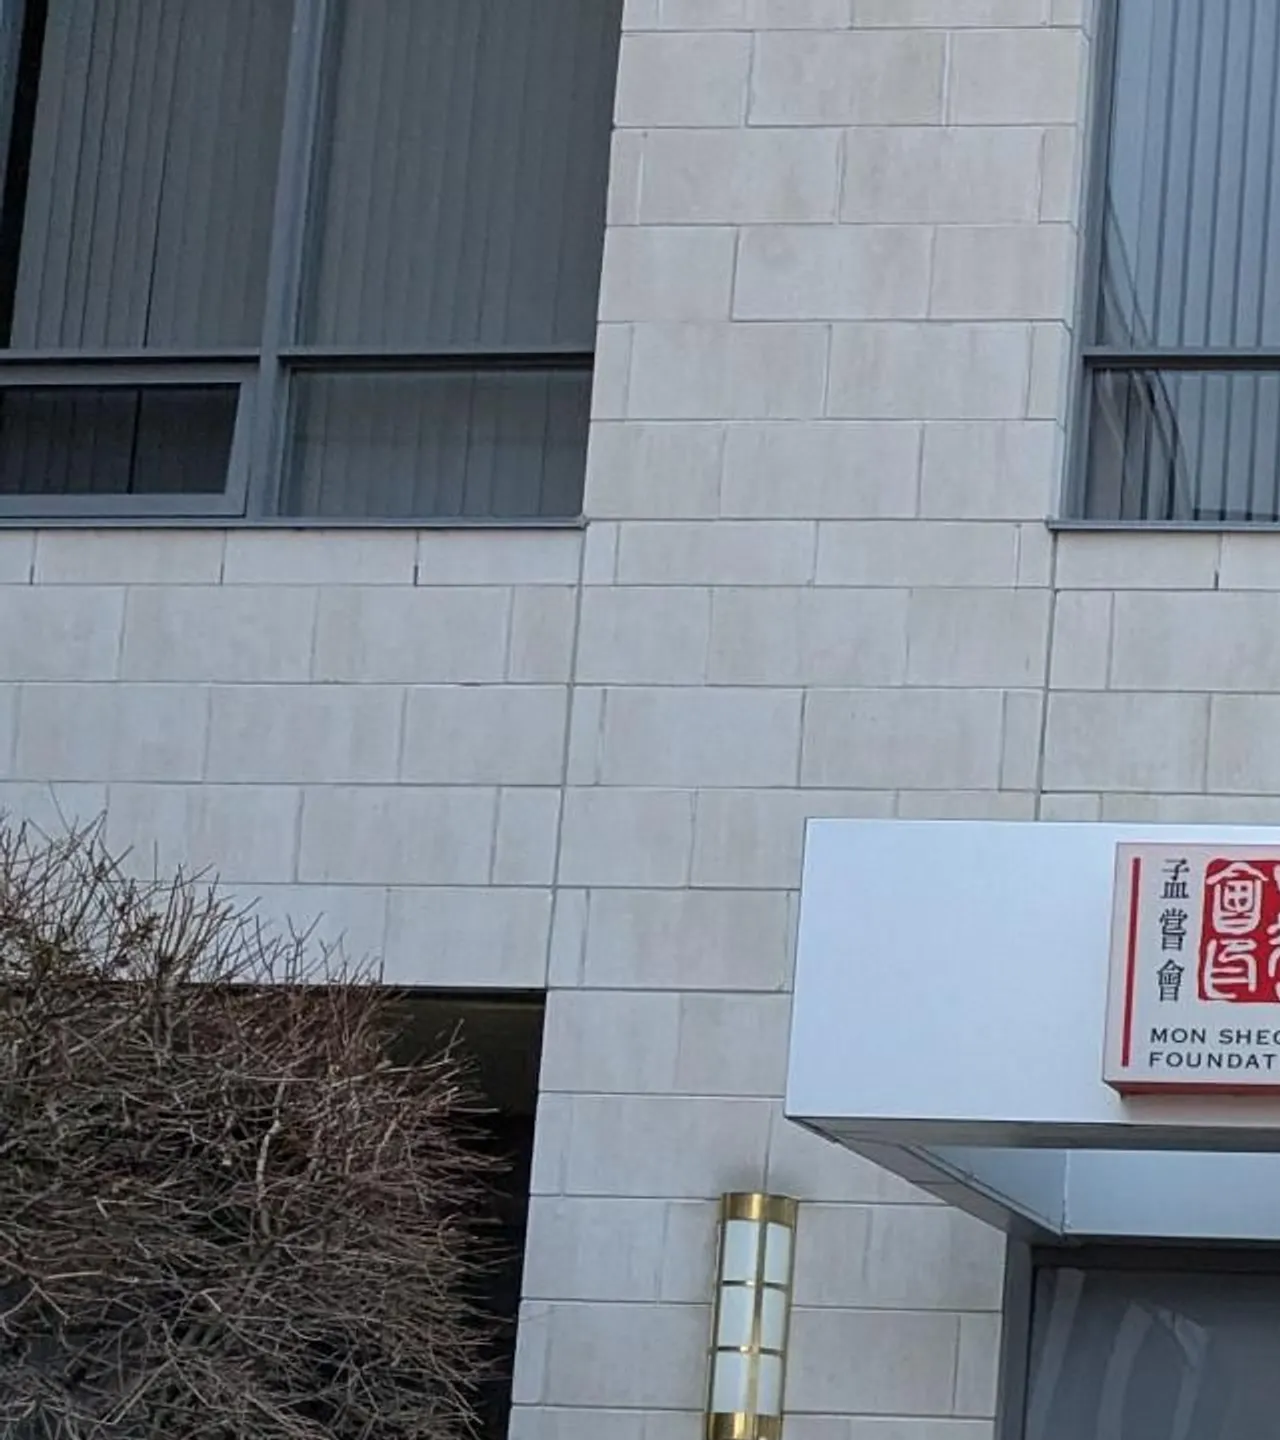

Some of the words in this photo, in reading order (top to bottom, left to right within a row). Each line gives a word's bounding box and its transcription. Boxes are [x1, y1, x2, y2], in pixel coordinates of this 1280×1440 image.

[1156, 858, 1190, 1002] 孟嘗會
[1150, 1028, 1206, 1044] MON
